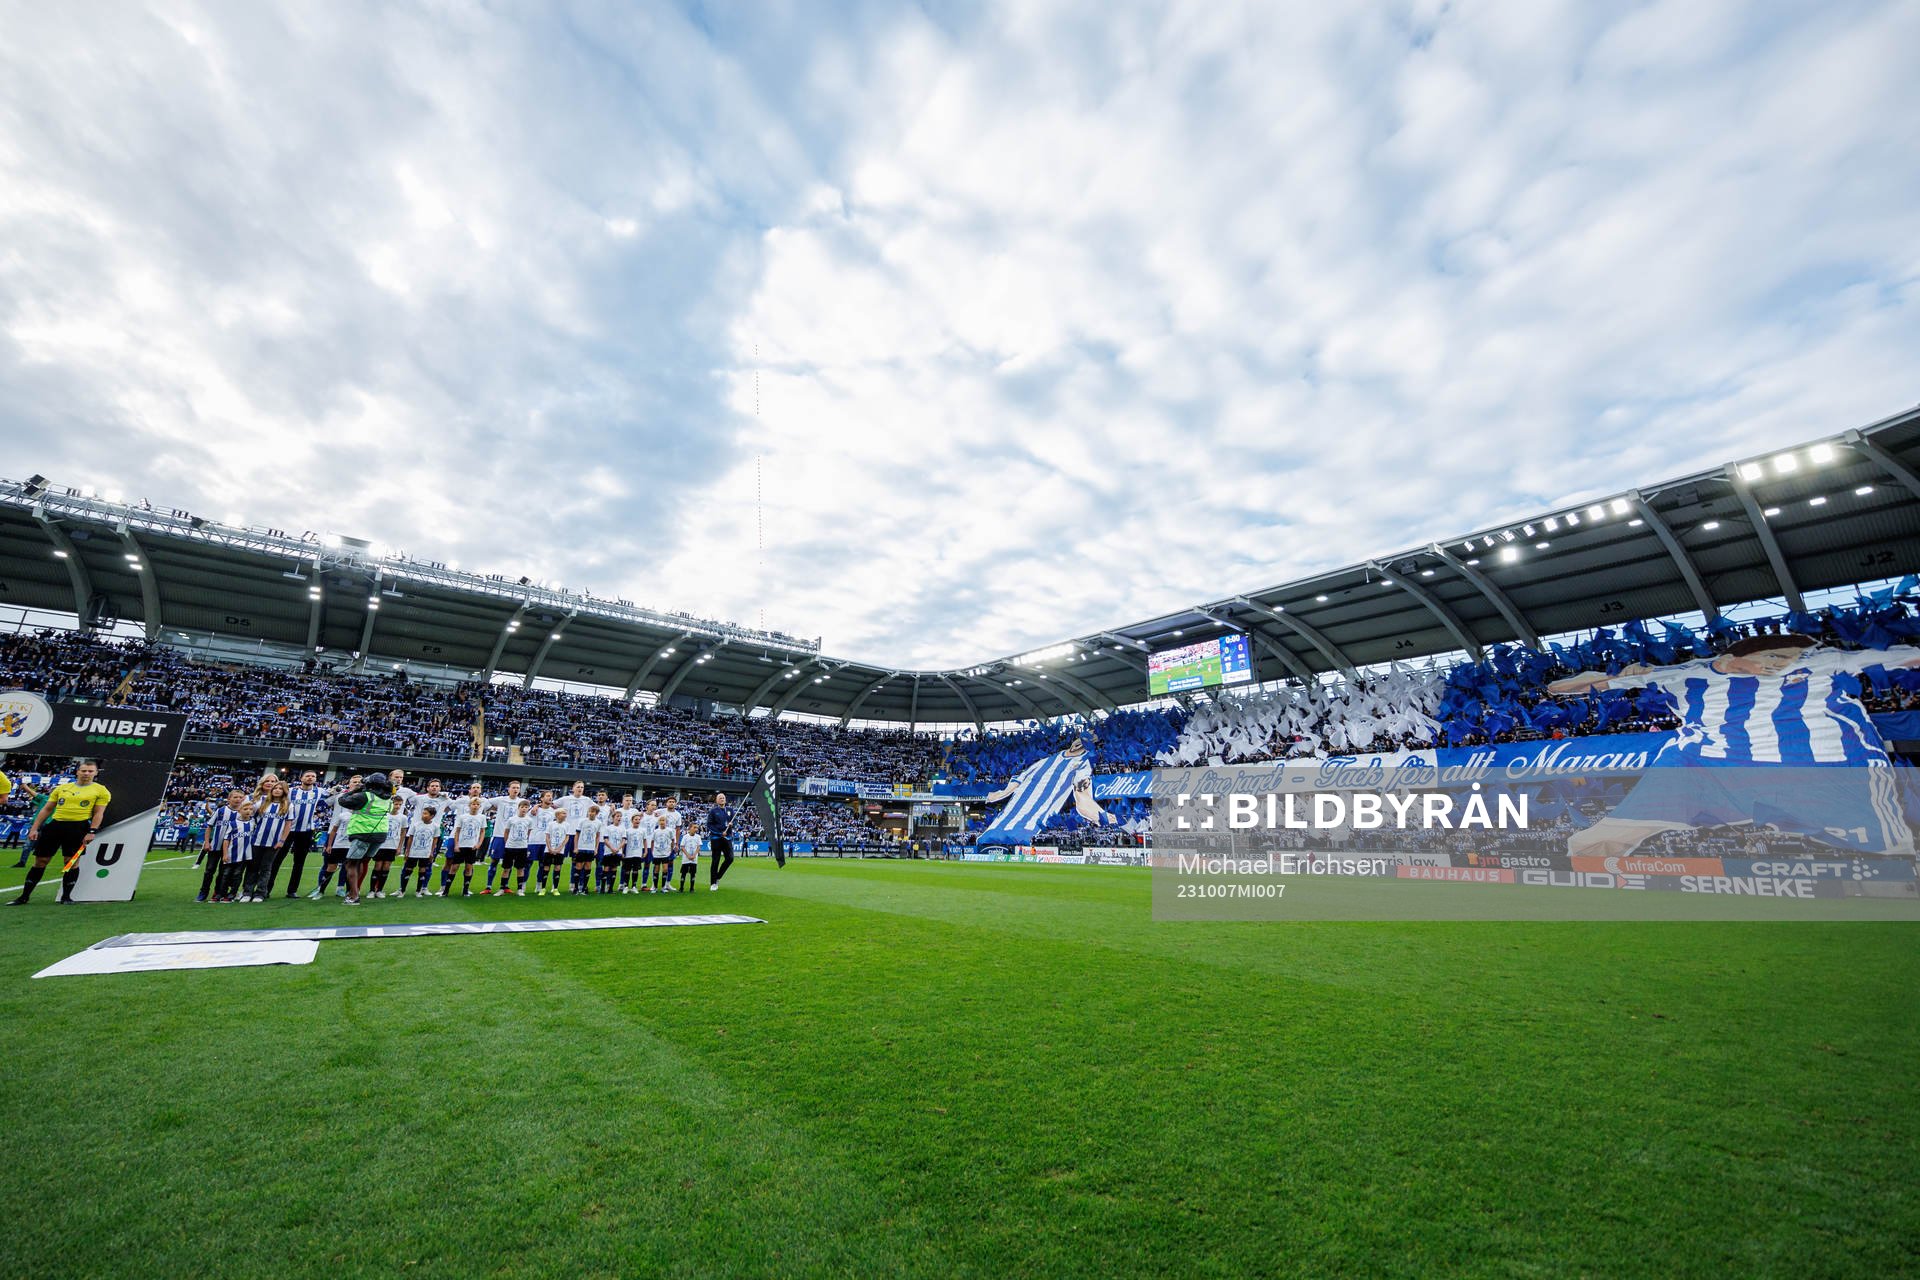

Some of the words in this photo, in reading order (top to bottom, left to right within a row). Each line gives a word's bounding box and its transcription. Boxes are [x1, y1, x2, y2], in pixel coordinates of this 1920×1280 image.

[1859, 550, 1896, 567] J2
[1600, 601, 1625, 613] J3
[1395, 640, 1414, 649] J4
[72, 716, 167, 738] UNIBET
[1097, 776, 1143, 797] Alltid
[1148, 772, 1190, 798] laget
[1314, 755, 1382, 788] Tack
[1388, 755, 1436, 791] för
[1441, 750, 1496, 782] allt
[1506, 742, 1647, 779] Marcus
[95, 842, 124, 867] U
[1409, 855, 1438, 867] law.
[1409, 867, 1500, 882] BAUHAUS
[1625, 859, 1687, 874] InfraCom
[1751, 862, 1848, 878] CRAFT
[1680, 875, 1816, 898] SERNEKE
